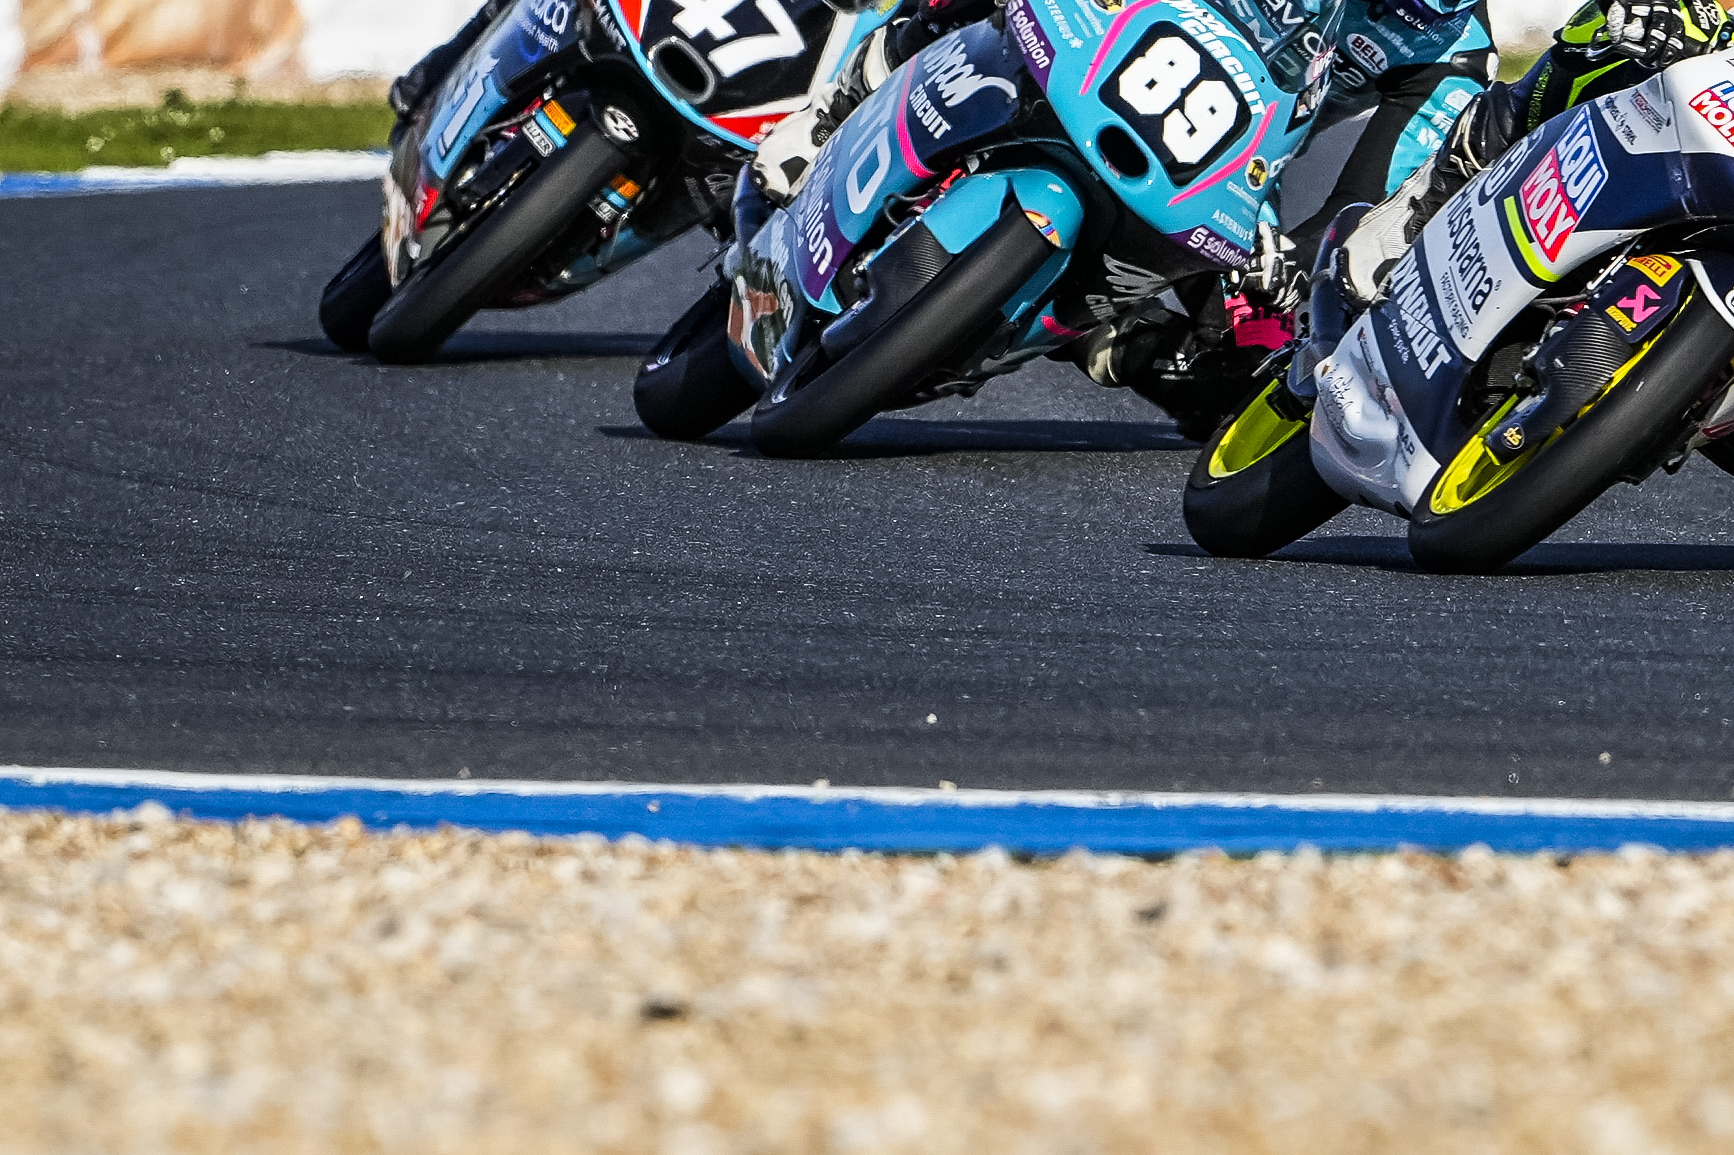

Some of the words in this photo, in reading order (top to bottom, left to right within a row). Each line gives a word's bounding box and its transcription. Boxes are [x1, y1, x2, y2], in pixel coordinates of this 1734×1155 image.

[1012, 9, 1051, 70] solunion
[1180, 18, 1265, 116] CIRCUIT
[1351, 36, 1390, 72] BELL
[908, 85, 953, 141] CIRCUIT
[1117, 35, 1240, 165] 89
[1524, 155, 1575, 250] MOLY
[1556, 124, 1602, 210] LIQUI
[1447, 182, 1494, 315] Husqvarna
[1391, 247, 1452, 380] DYNAVOLT
